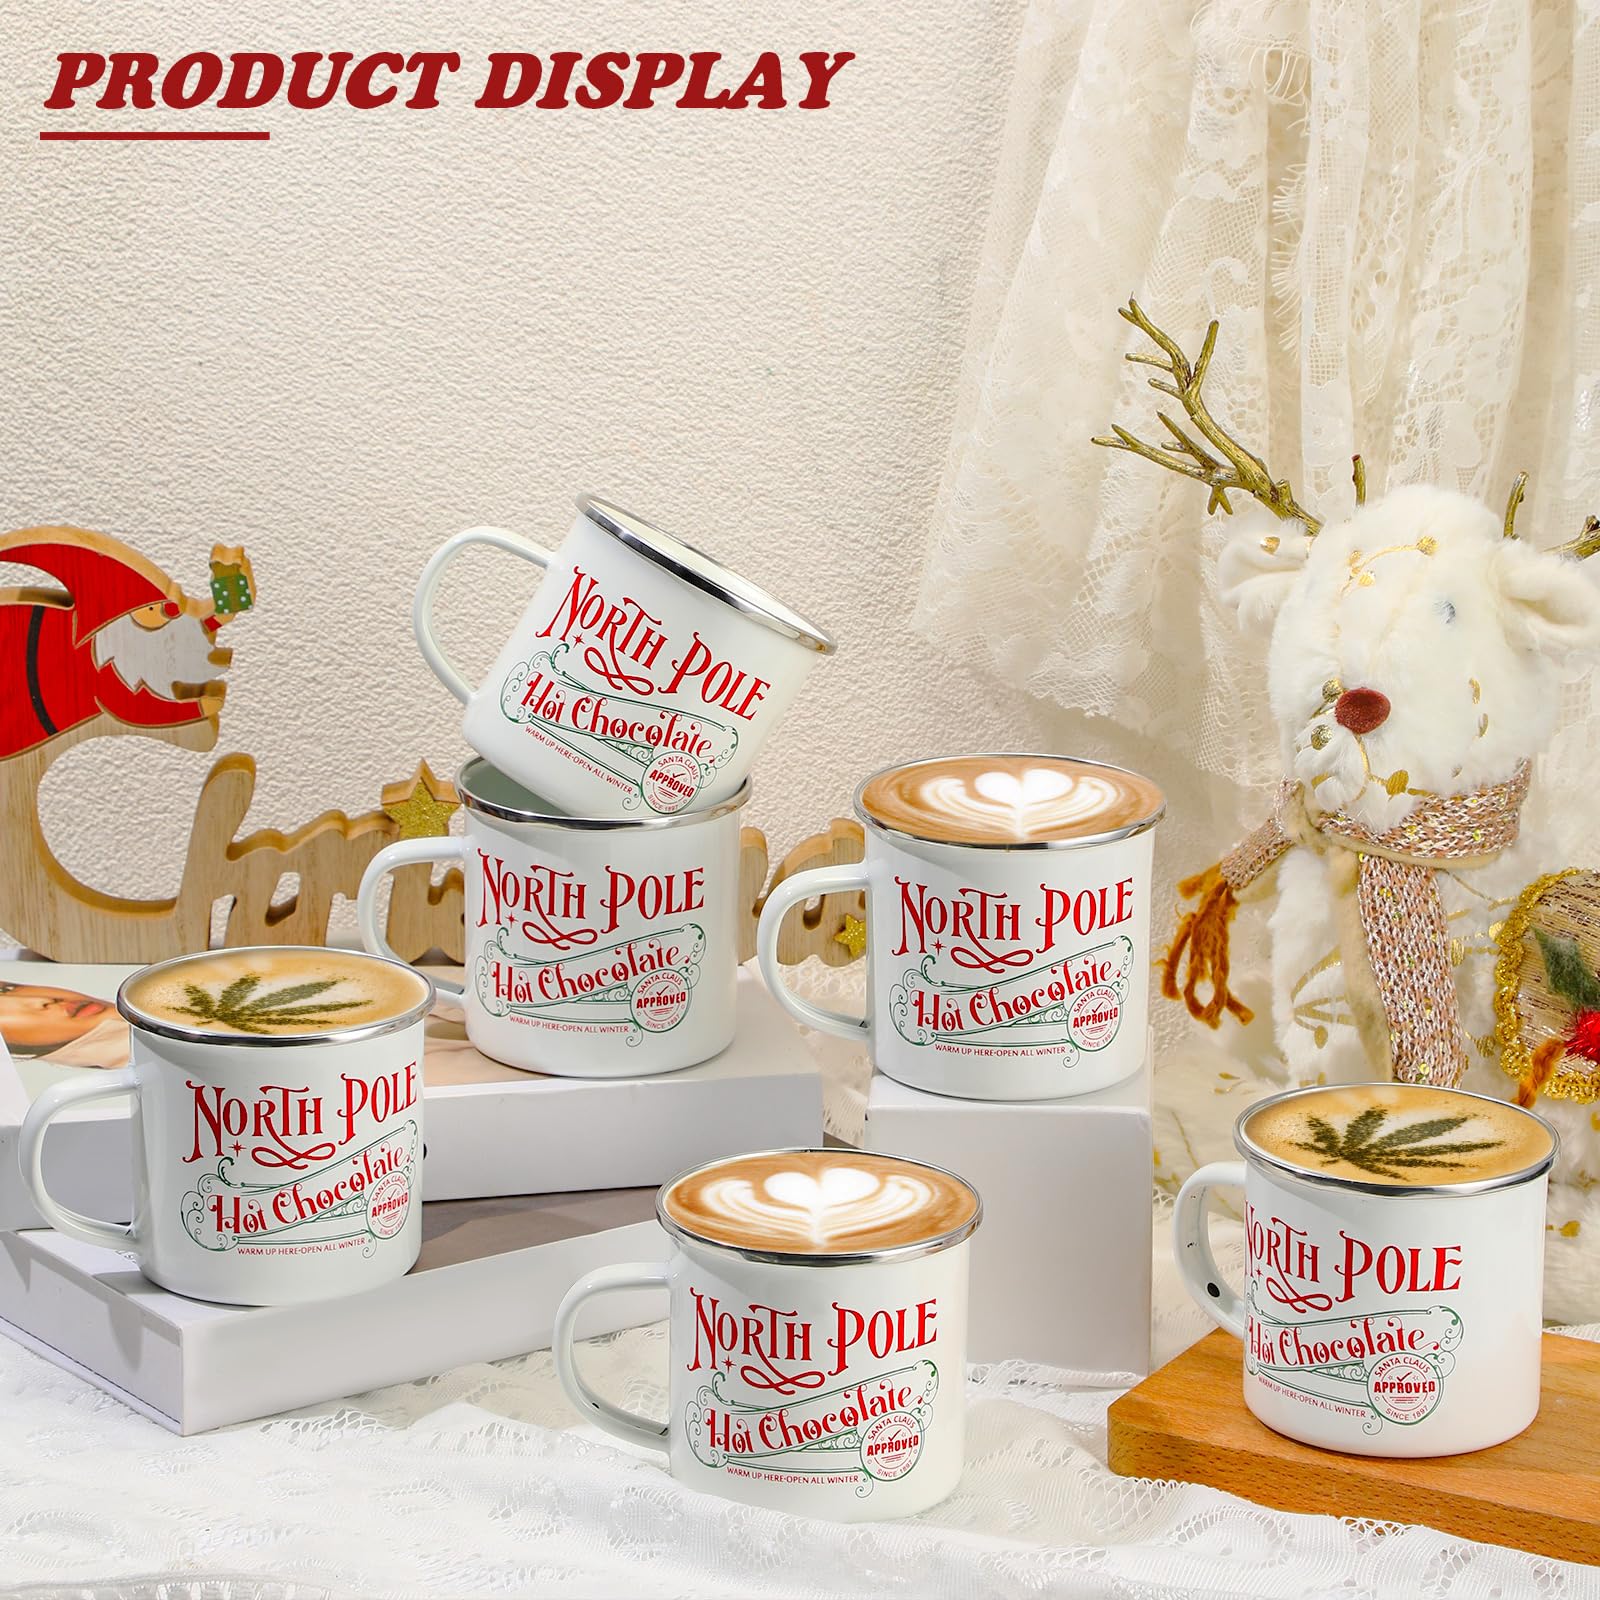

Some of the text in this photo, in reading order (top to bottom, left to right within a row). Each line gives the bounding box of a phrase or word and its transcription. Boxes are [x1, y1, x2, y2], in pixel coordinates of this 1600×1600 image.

[571, 696, 715, 764] Chocolate
[525, 726, 546, 743] WARM
[544, 737, 556, 748] UP
[592, 767, 606, 779] ALL
[606, 775, 633, 794] WINTER
[658, 756, 699, 780] SANTA CLAUS
[649, 769, 694, 798] APPROVED
[538, 939, 690, 1000] Chocolate
[637, 972, 683, 994] SANTA CLAUS
[969, 954, 1120, 1026] Chocolate
[636, 992, 686, 1009] APPROVED
[1073, 988, 1115, 1013] SANTA CLAUS
[510, 1015, 530, 1026] WARM
[584, 1025, 597, 1033] ALL
[600, 1025, 629, 1033] WINTER
[1073, 1007, 1118, 1028] APPROVED
[935, 1043, 960, 1054] WARM
[1036, 1046, 1066, 1056] WINTER
[272, 1141, 410, 1225] Chocolate
[372, 1179, 390, 1201] SANTA
[371, 1192, 408, 1218] APPROVED
[237, 1247, 263, 1255] WARM
[265, 1247, 276, 1255] UP
[323, 1244, 336, 1252] ALL
[338, 1237, 365, 1249] WINTER
[1279, 1315, 1440, 1367] Chocolate
[1375, 1356, 1431, 1378] SANTA CLAUS
[1373, 1381, 1436, 1393] APPROVED
[1273, 1382, 1281, 1392] UP
[1320, 1400, 1334, 1412] ALL
[1335, 1404, 1367, 1418] WINTER
[759, 1378, 923, 1450] Chocolate
[1385, 1405, 1429, 1421] SINCE 1897
[868, 1415, 916, 1440] SANTA CLAUS
[866, 1435, 919, 1456] APPROVED
[727, 1466, 750, 1478] WARM
[752, 1471, 762, 1480] UP
[811, 1476, 825, 1484] ALL
[827, 1475, 859, 1484] WINTER
